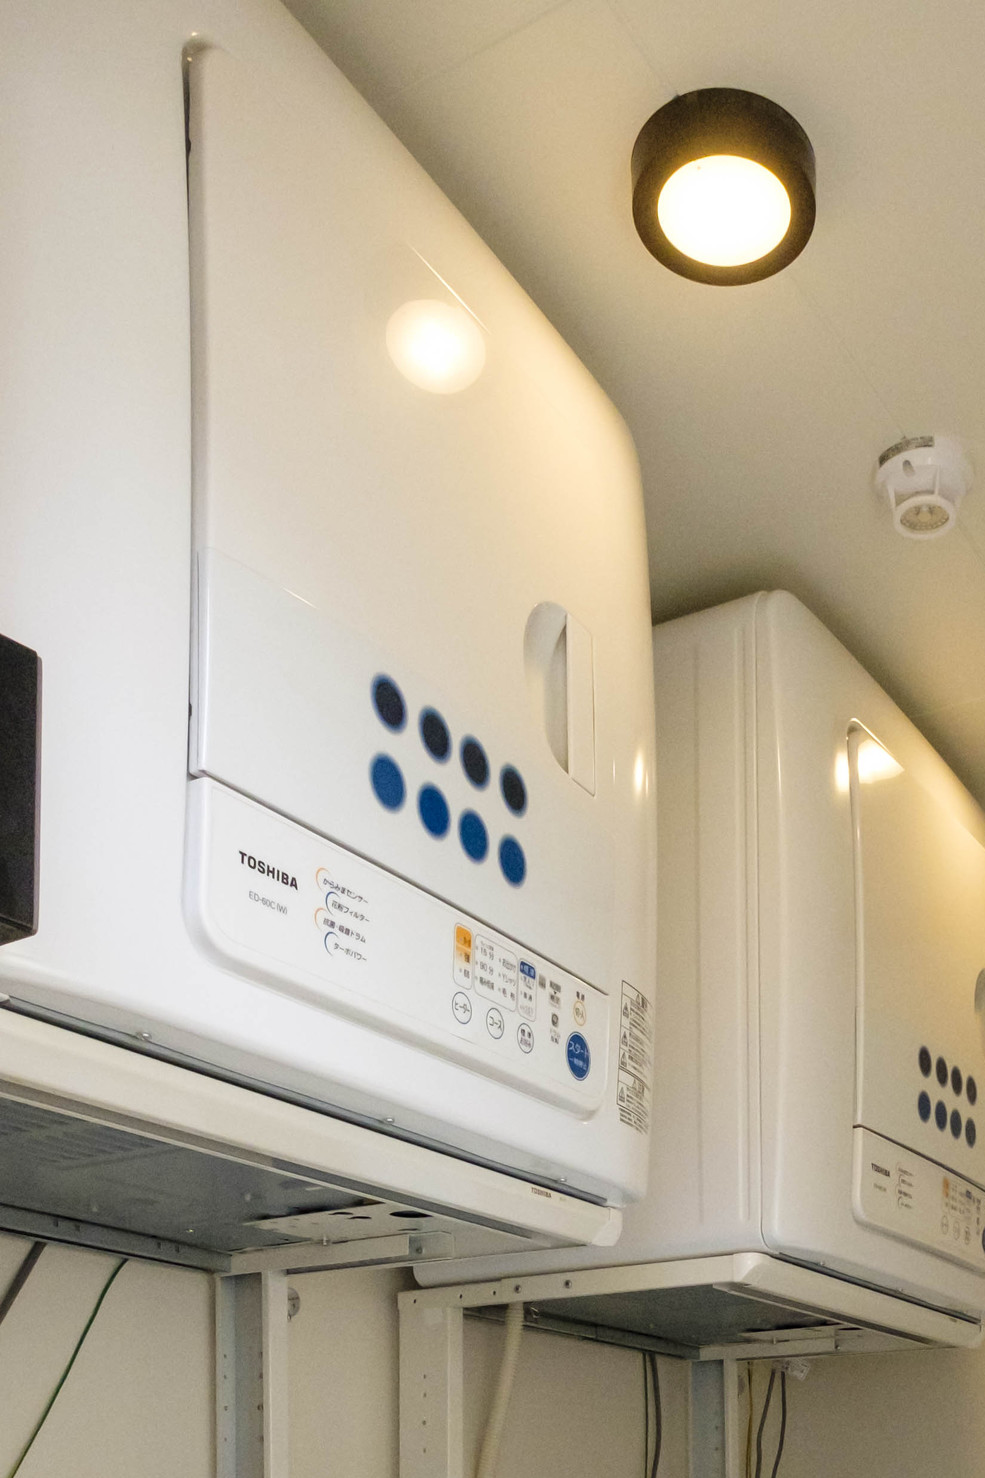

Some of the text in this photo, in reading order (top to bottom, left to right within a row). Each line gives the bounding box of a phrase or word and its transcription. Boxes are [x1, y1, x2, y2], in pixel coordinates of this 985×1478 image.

[238, 850, 299, 891] TOSHIBA
[489, 1016, 503, 1032] コース
